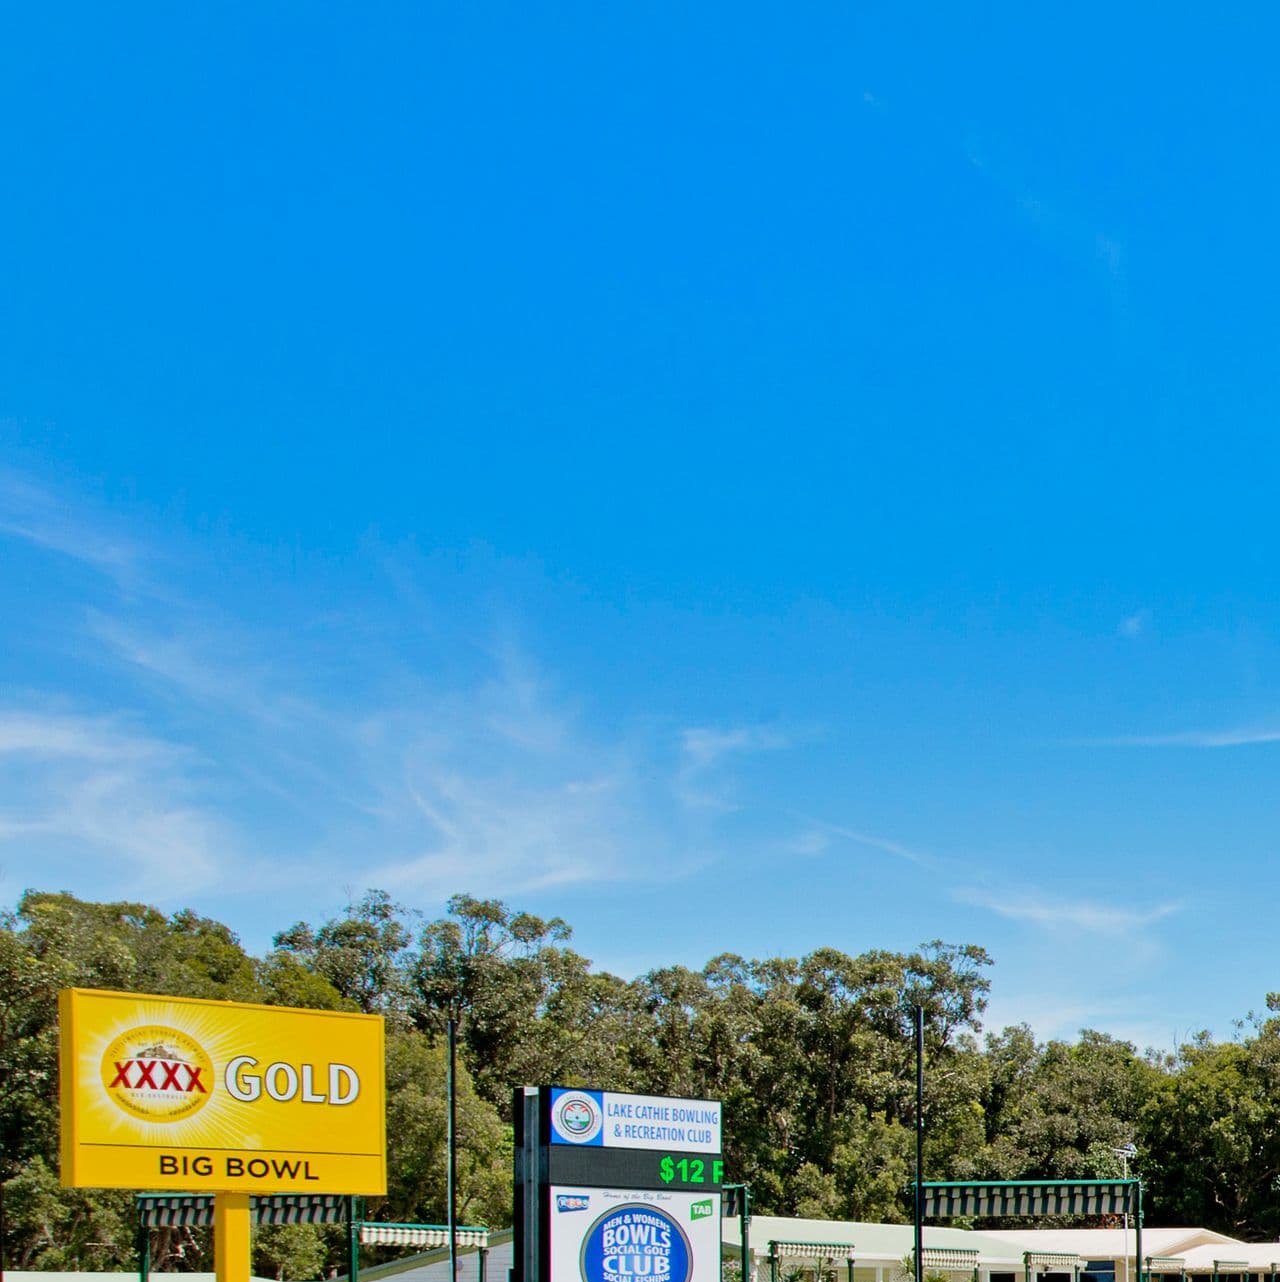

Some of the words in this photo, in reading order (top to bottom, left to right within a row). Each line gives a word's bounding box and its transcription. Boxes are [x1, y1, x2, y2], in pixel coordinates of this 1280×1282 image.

[109, 1060, 208, 1094] XXXX
[224, 1056, 360, 1106] GOLD
[607, 1103, 634, 1119] LAKE
[635, 1105, 670, 1121] CATHIE
[672, 1107, 718, 1125] BOWLING
[614, 1124, 623, 1138] &
[625, 1125, 685, 1142] RECREATION
[687, 1129, 712, 1143] CLUB
[159, 1155, 214, 1176] BIG
[226, 1157, 319, 1180] BOWL
[659, 1155, 705, 1184] $12
[692, 1204, 711, 1215] TAB
[603, 1215, 622, 1231] MEN
[623, 1214, 632, 1224] &
[632, 1214, 671, 1232] WOMENS
[603, 1224, 671, 1248] BOWLS
[603, 1245, 641, 1256] SOCIAL
[644, 1246, 671, 1256] GOLF
[602, 1255, 671, 1275] CLUB
